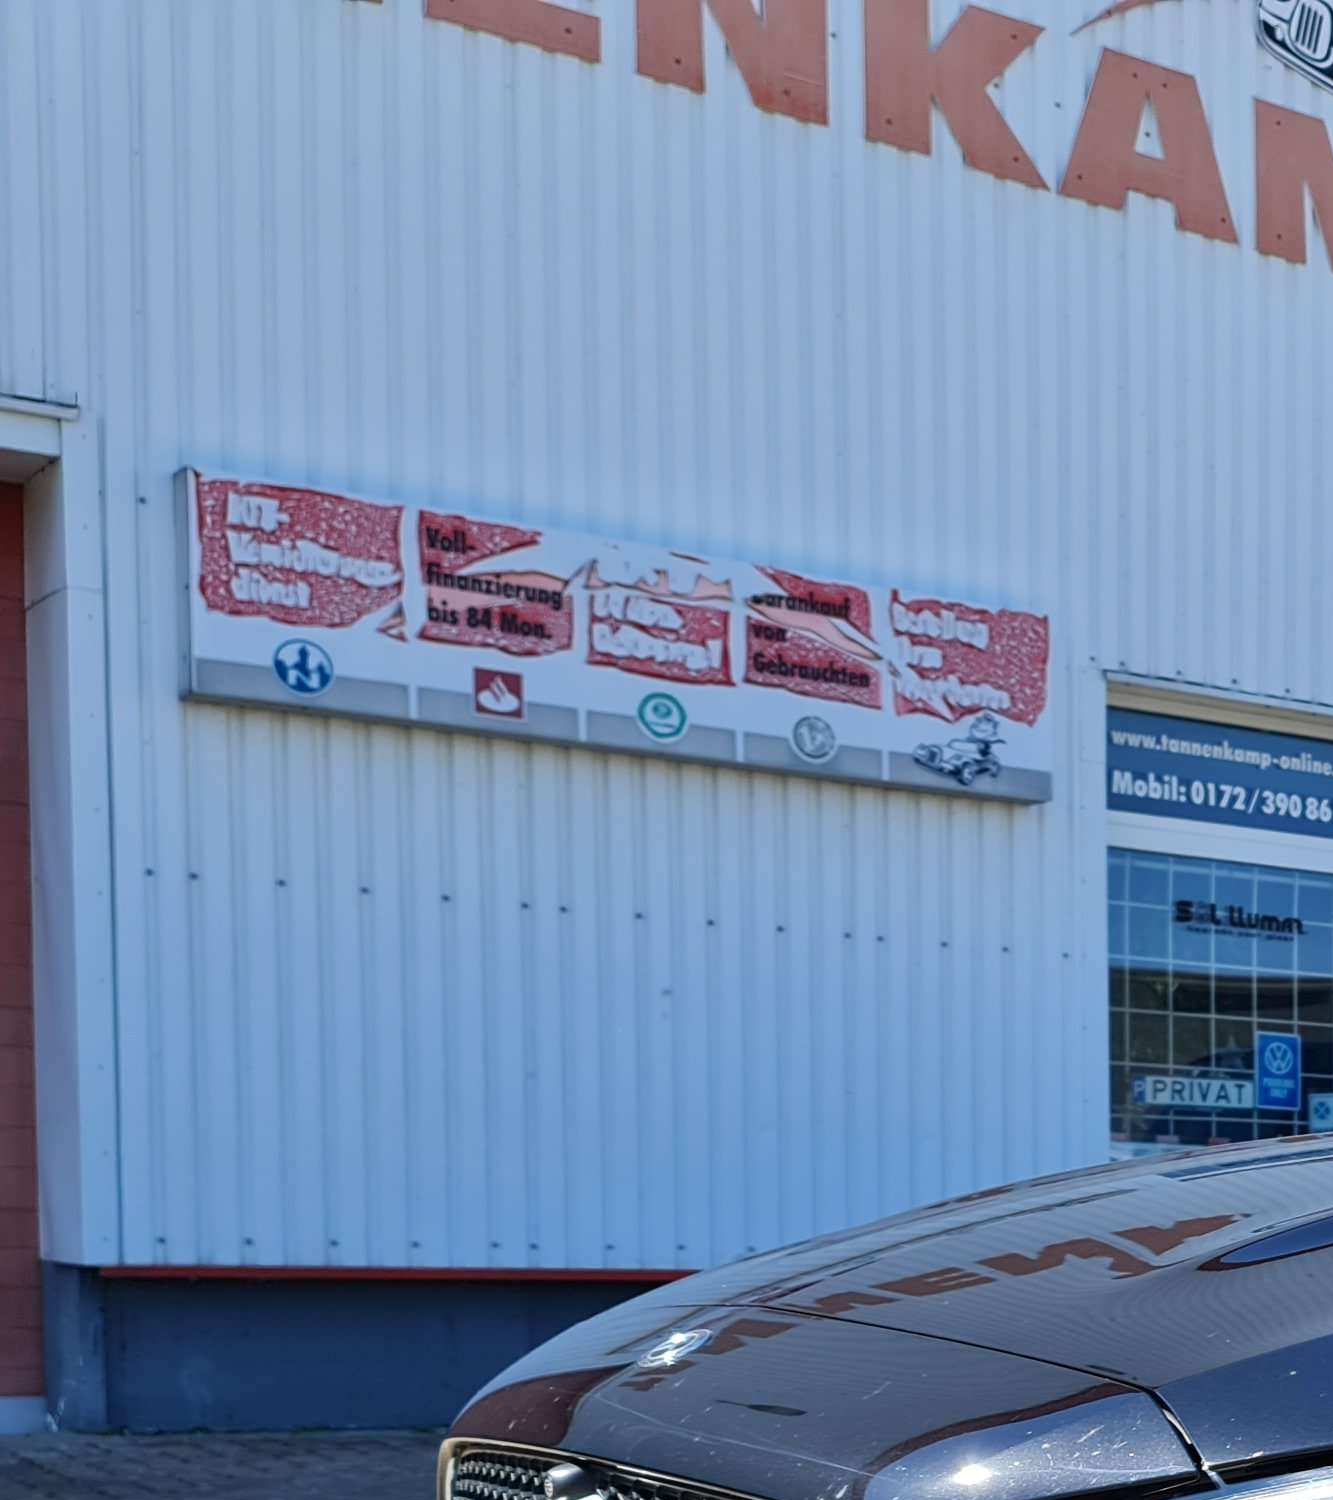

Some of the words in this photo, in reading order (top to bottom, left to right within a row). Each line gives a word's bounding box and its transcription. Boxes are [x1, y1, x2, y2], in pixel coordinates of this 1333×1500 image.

[426, 526, 475, 554] Voll-
[427, 562, 562, 611] finanzierung
[427, 599, 458, 626] bis
[467, 606, 492, 630] 84
[500, 611, 552, 639] Mon.
[752, 624, 787, 642] von
[752, 652, 871, 688] Gebrauchten
[1111, 769, 1187, 802] Mobil:
[1153, 1080, 1246, 1105] PRIVAT
